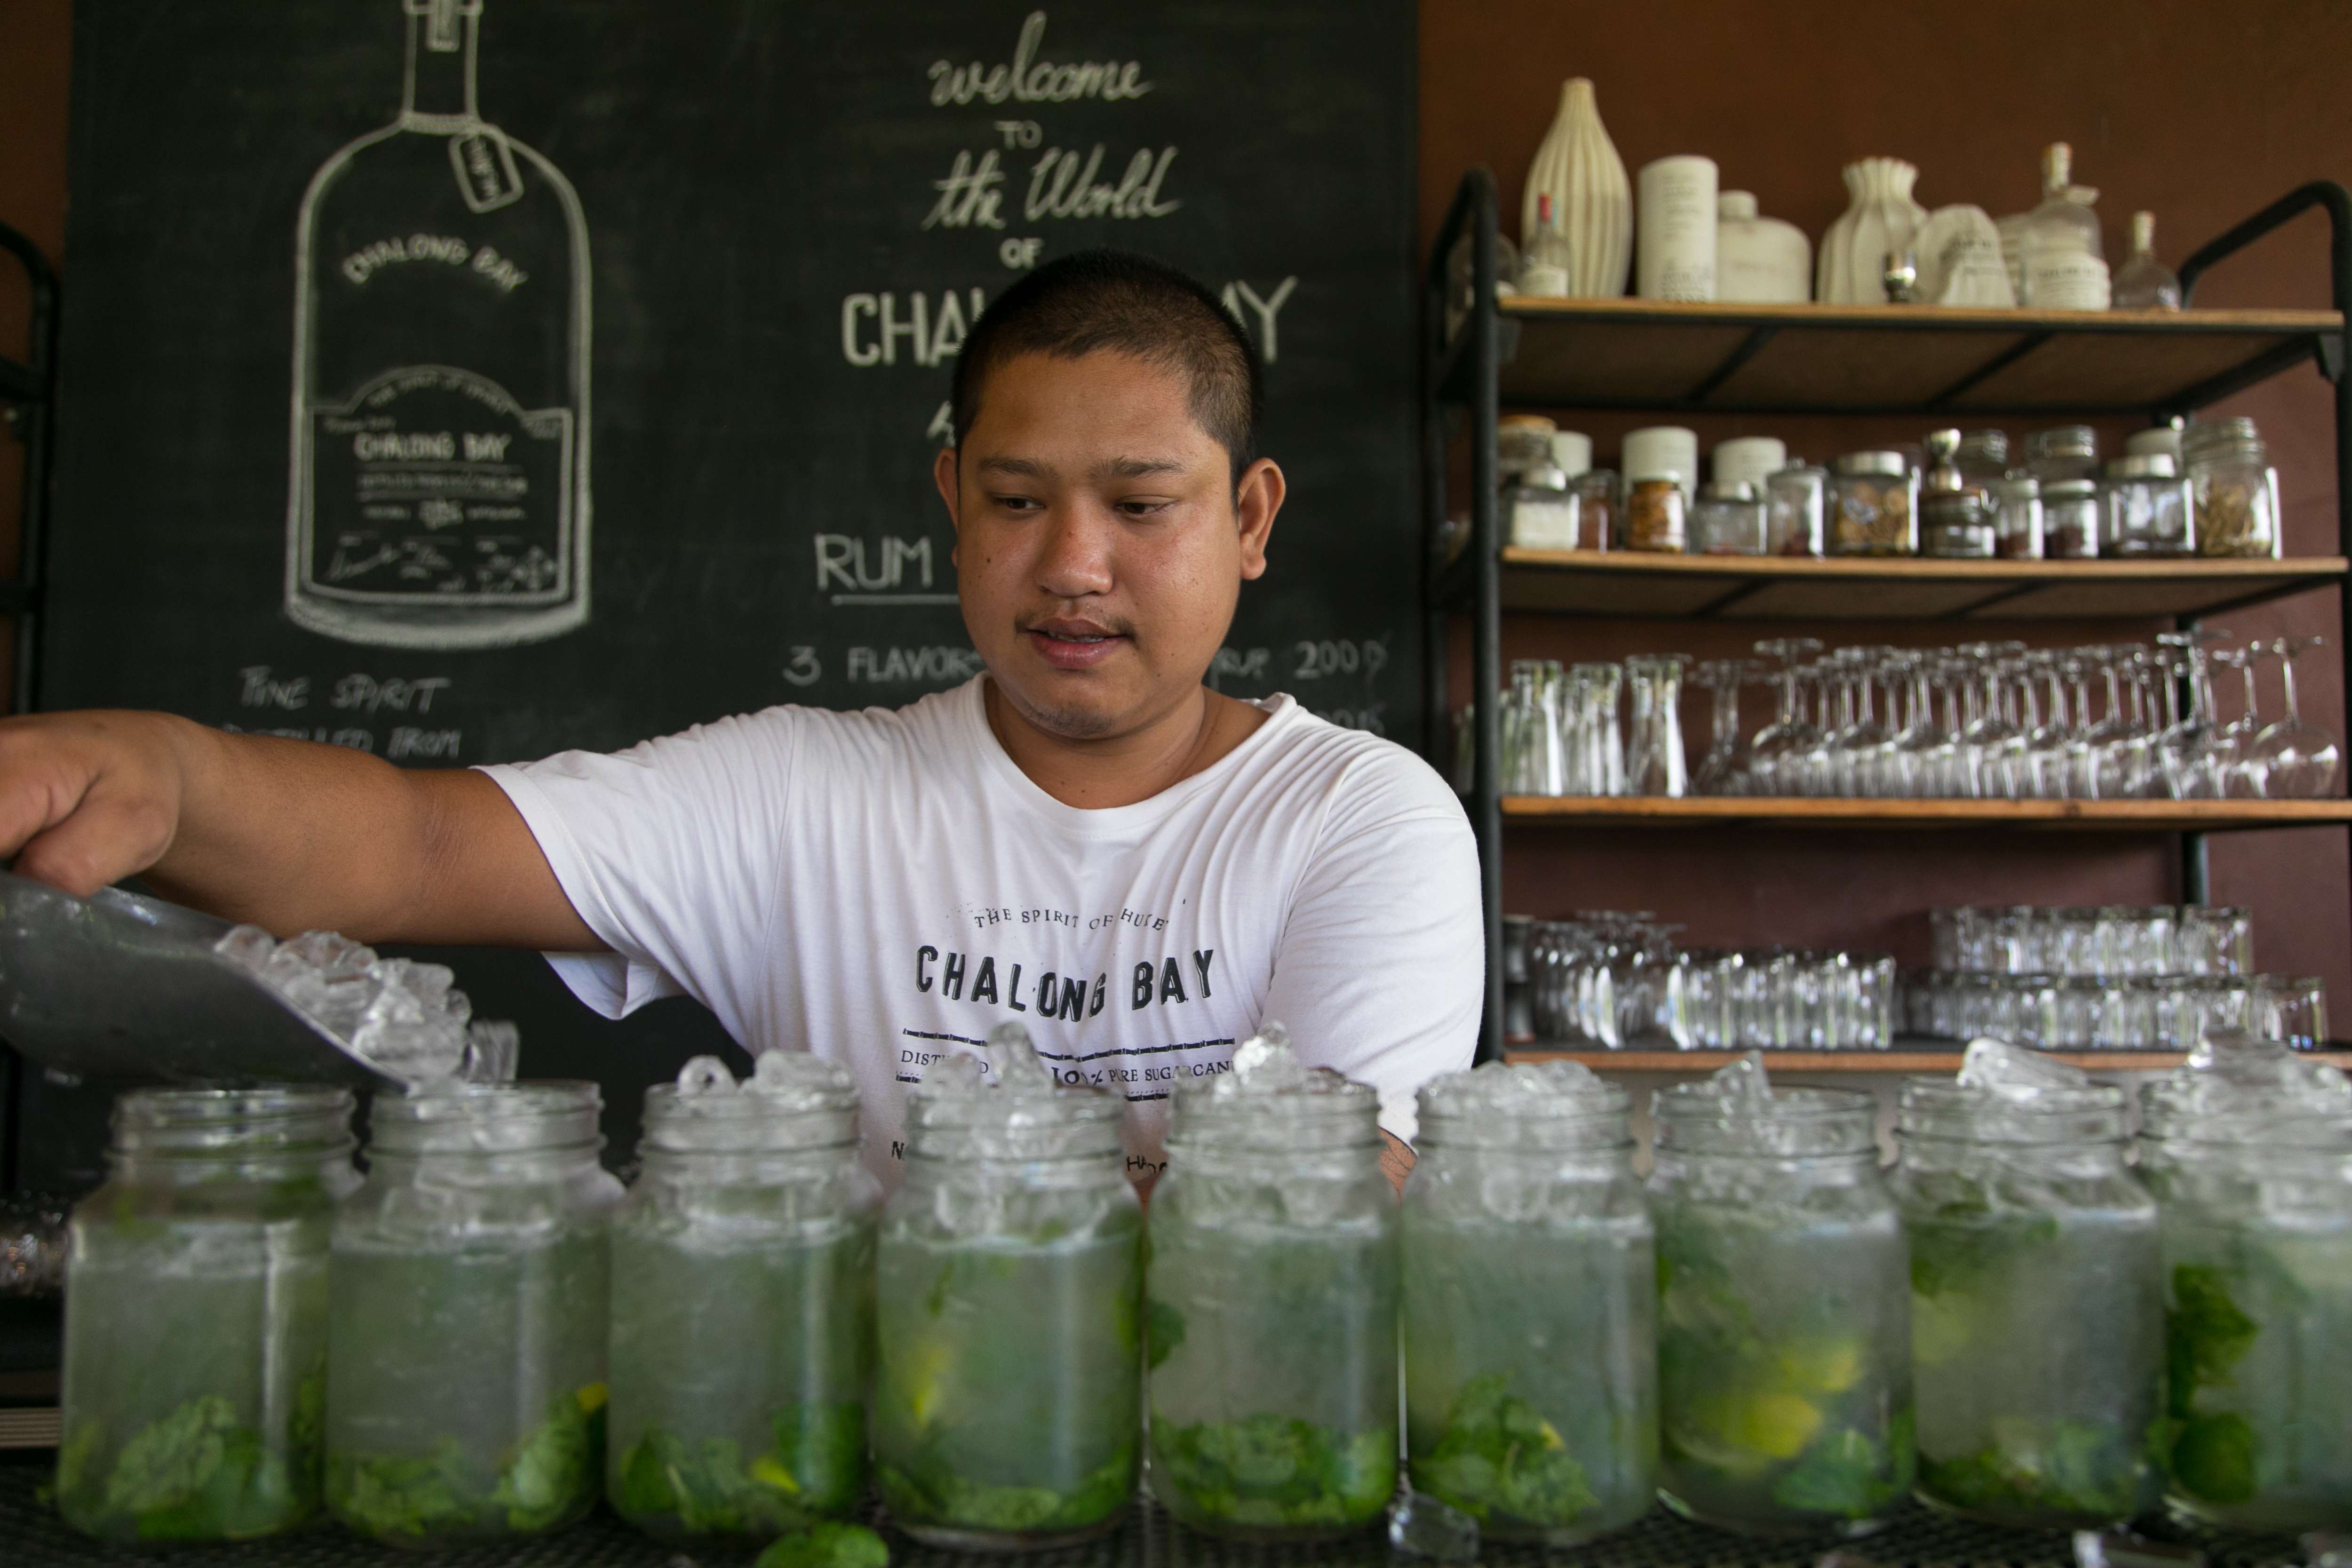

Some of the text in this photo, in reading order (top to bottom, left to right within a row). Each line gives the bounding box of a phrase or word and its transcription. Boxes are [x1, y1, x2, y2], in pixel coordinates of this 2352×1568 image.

[927, 9, 1155, 106] welcome
[994, 119, 1043, 149] TO
[920, 143, 1184, 231] the World
[1000, 237, 1044, 270] OF
[813, 532, 933, 591] RUM
[782, 645, 822, 686] 3
[974, 908, 1011, 929] THE
[1022, 909, 1079, 928] SPIRIT
[1089, 915, 1113, 930] OF
[916, 946, 1214, 1022] CHALONG BAY
[1108, 1069, 1138, 1082] PURE
